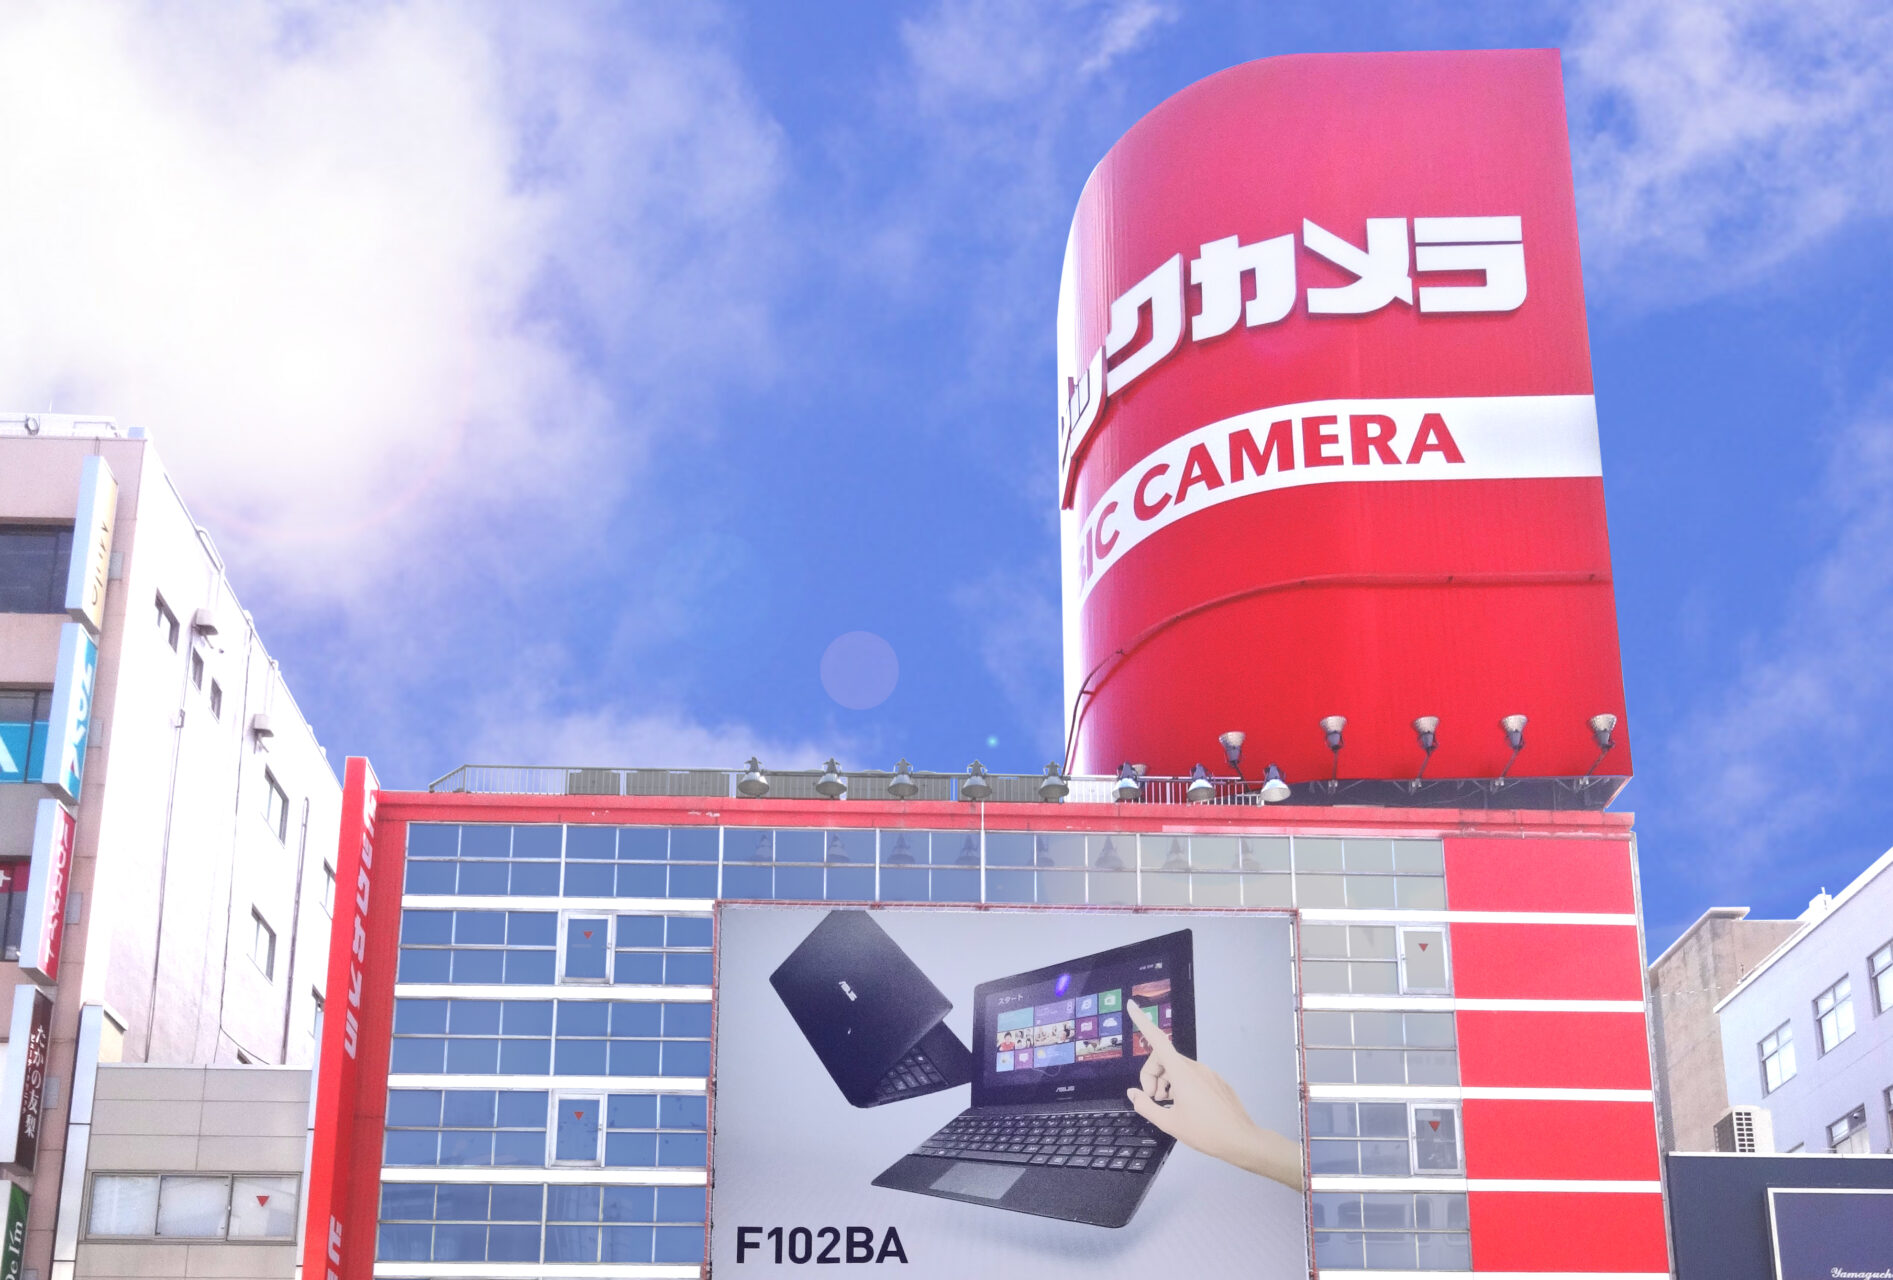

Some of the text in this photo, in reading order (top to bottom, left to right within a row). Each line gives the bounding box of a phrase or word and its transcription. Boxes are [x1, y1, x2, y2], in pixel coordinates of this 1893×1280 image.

[1059, 216, 1528, 511] ックカメラ
[1133, 412, 1466, 520] CAMERA
[24, 1024, 48, 1139] たかの友梨
[735, 1225, 909, 1265] F102BA
